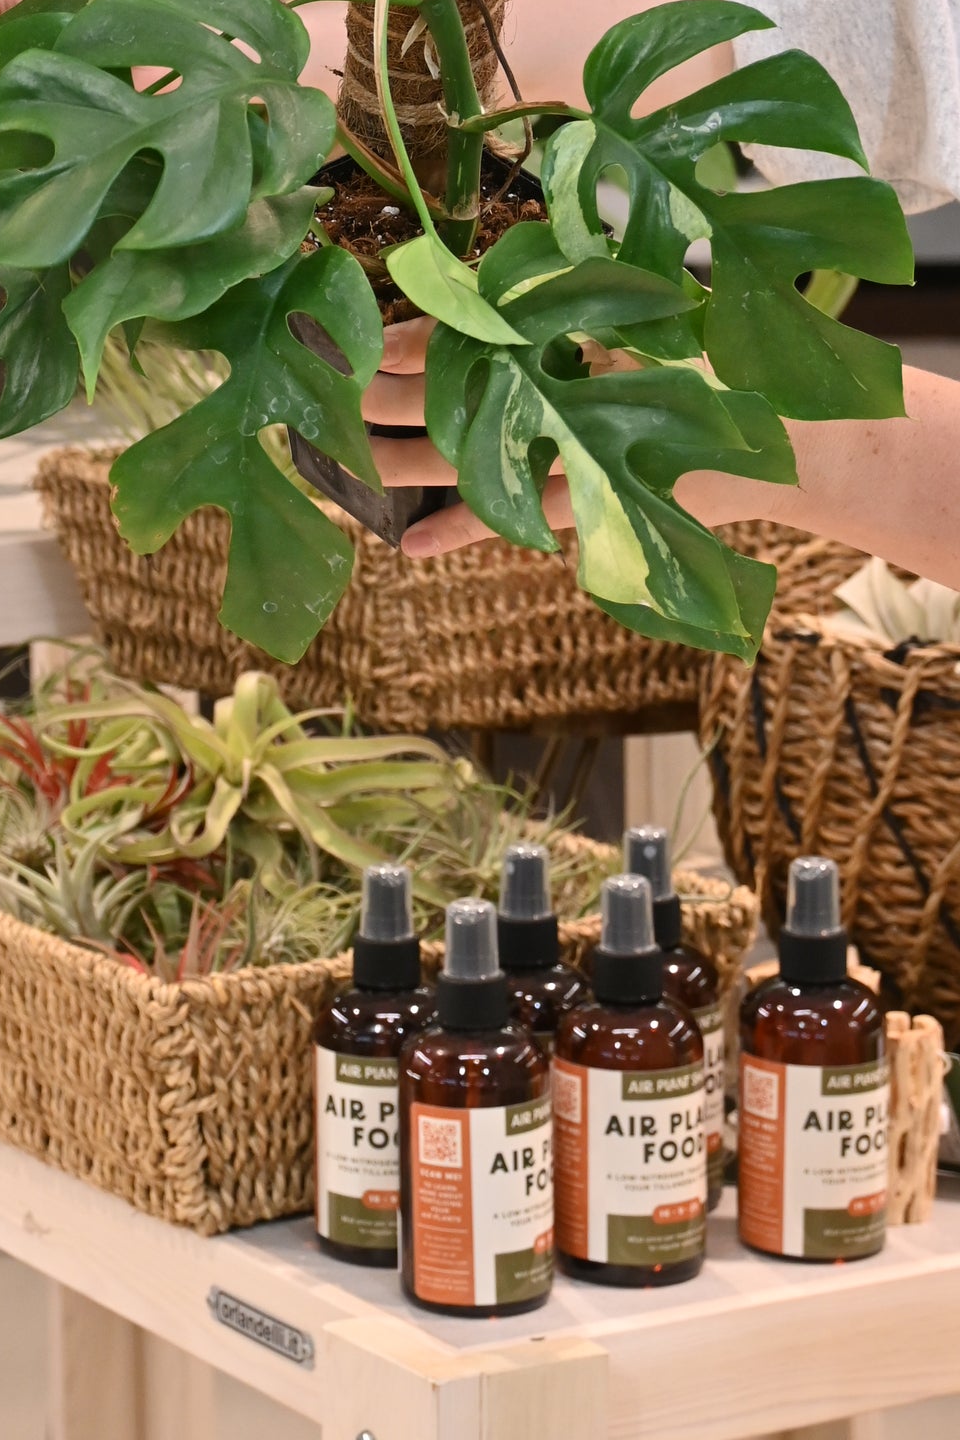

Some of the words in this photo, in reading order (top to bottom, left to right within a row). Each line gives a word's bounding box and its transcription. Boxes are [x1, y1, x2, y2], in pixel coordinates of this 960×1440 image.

[339, 1063, 363, 1079] AIR
[627, 1079, 655, 1094] AIR
[827, 1074, 853, 1089] AIR
[326, 1094, 366, 1120] AIR
[510, 1113, 532, 1128] AIR
[604, 1114, 657, 1137] AIR
[802, 1110, 854, 1132] AIR
[490, 1147, 535, 1175] AIR
